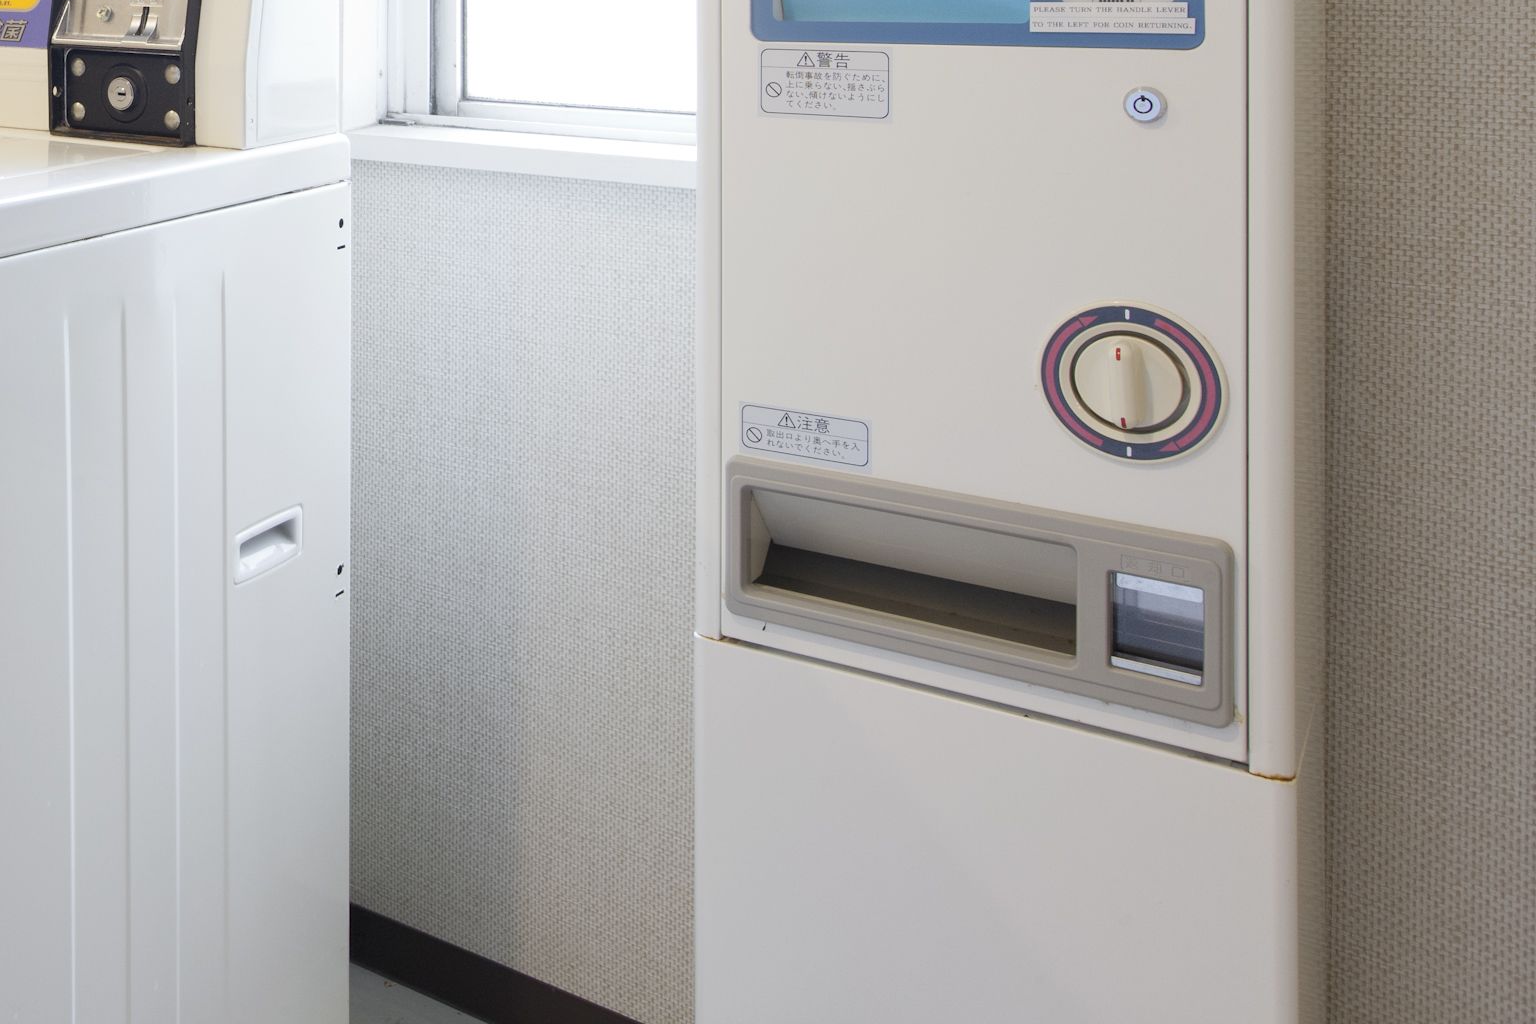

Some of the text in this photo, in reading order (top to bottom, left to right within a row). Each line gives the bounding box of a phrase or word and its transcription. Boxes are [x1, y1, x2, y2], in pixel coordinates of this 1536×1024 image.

[817, 52, 851, 69] 警告
[786, 70, 886, 83] 転倒事故を防ぐために、
[786, 80, 885, 92] 上に乗らない、揺さぶら
[786, 90, 884, 103] ない、傾けないようにし
[786, 100, 837, 111] てください。
[797, 415, 830, 434] 注意
[766, 428, 861, 452] 取出口より奥へ手を入
[767, 439, 846, 460] れないでください。
